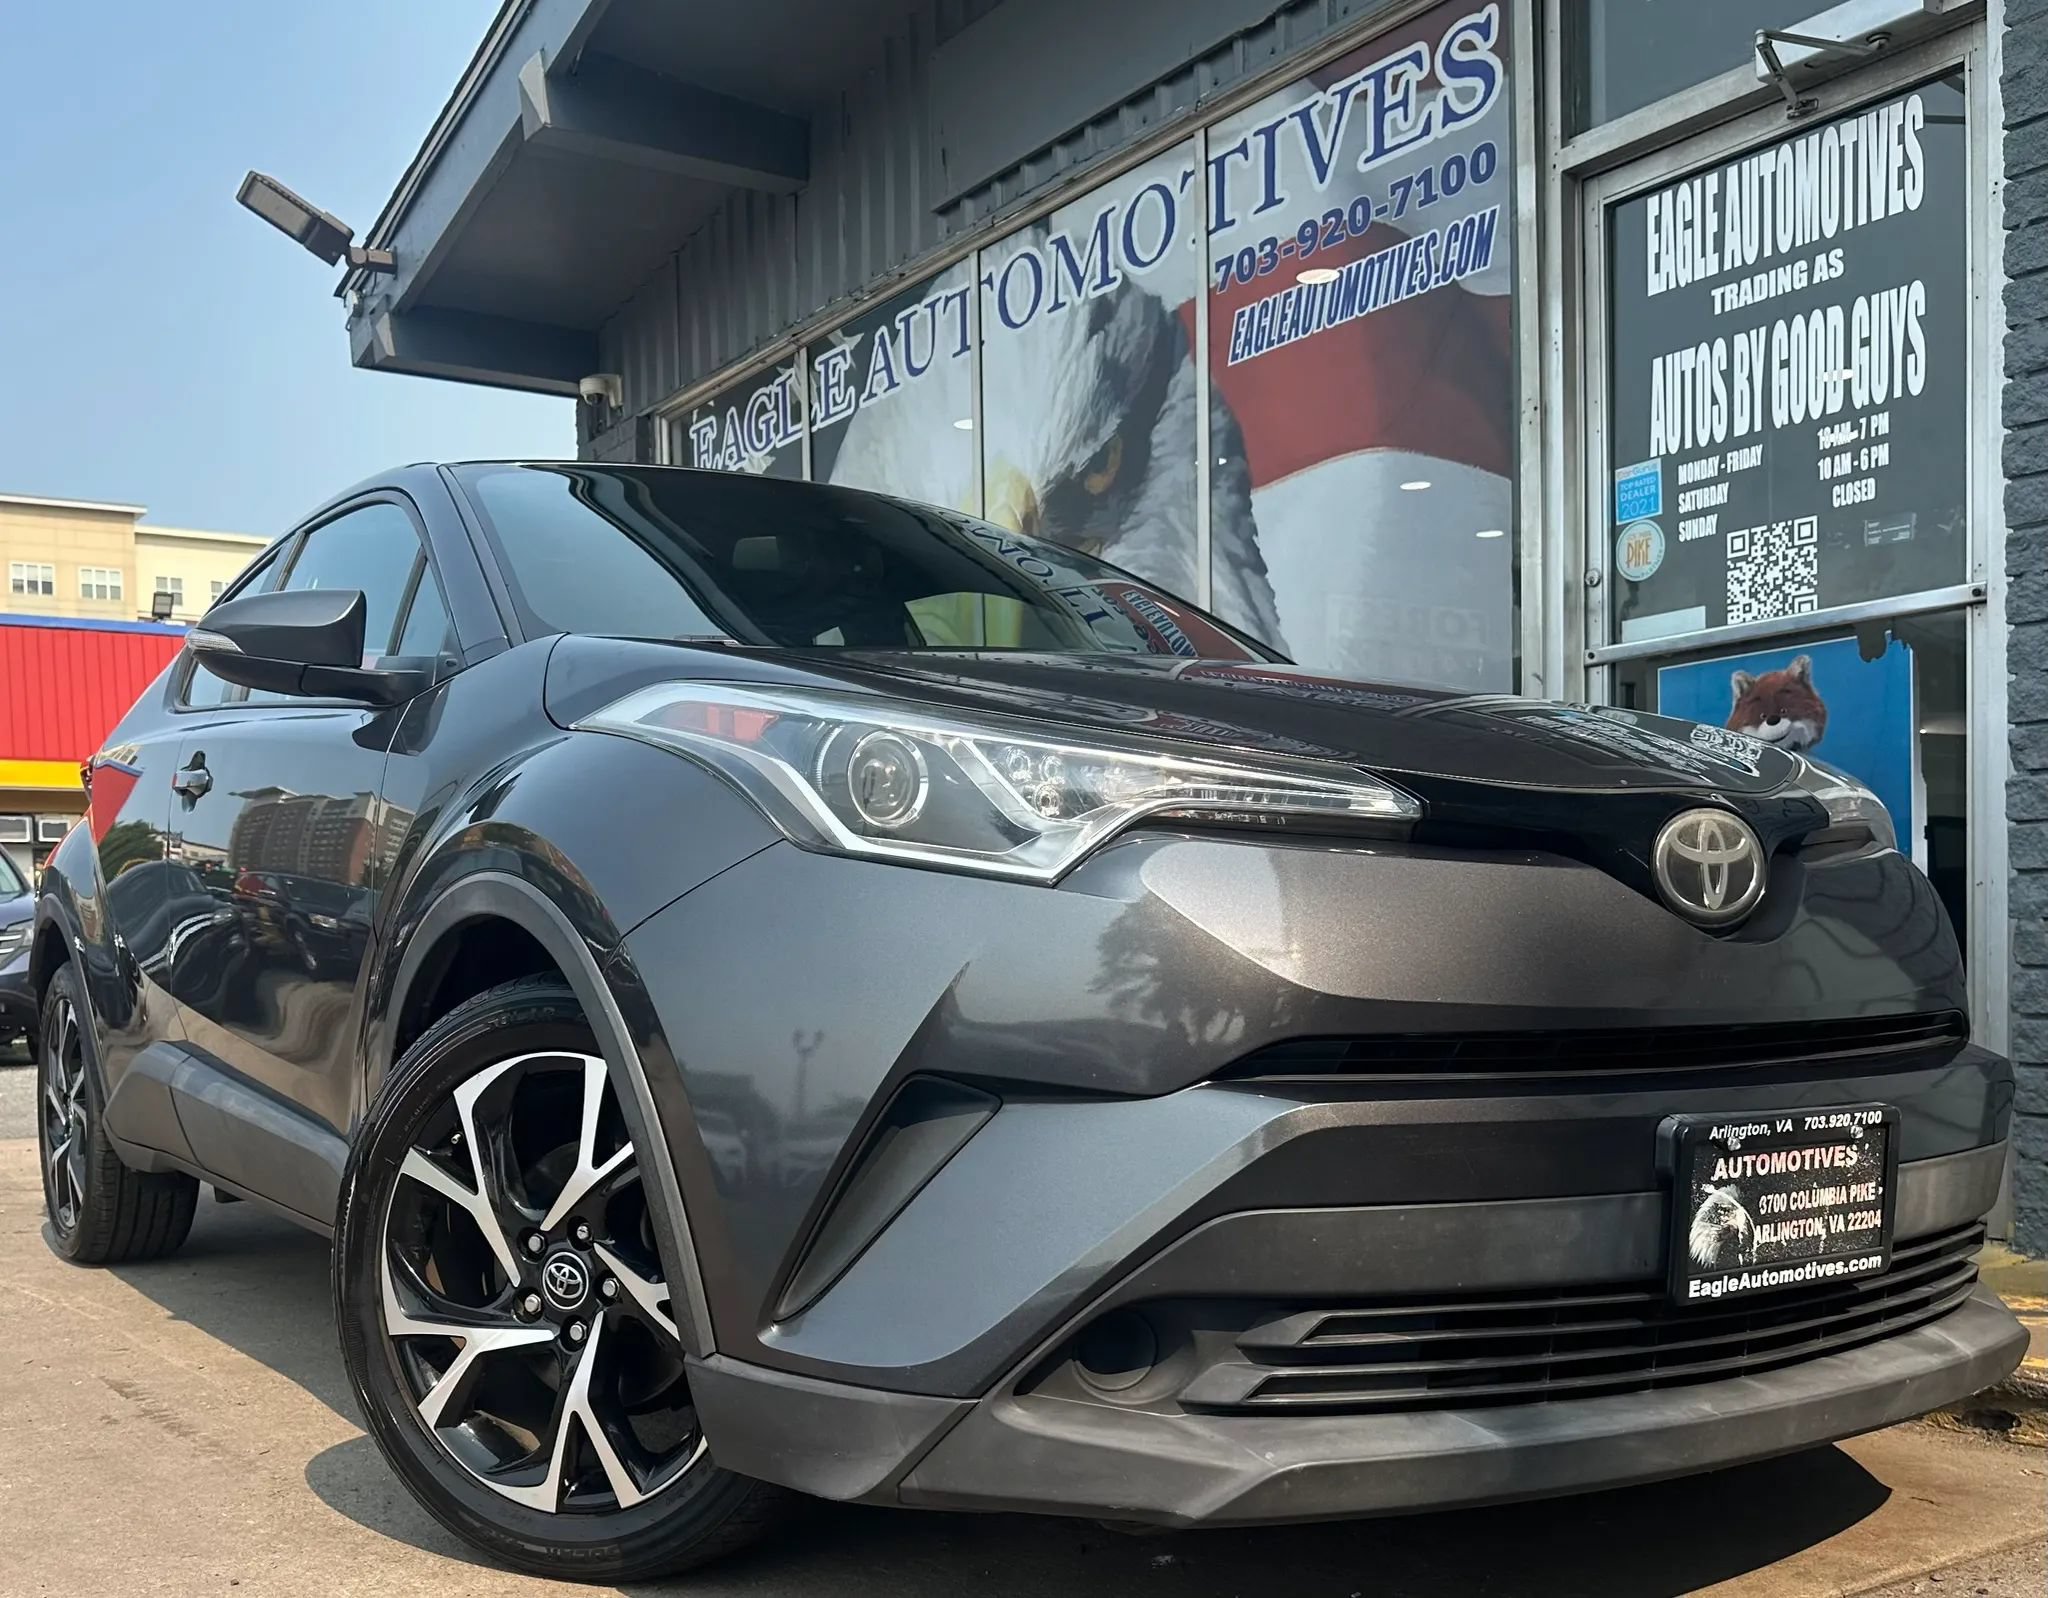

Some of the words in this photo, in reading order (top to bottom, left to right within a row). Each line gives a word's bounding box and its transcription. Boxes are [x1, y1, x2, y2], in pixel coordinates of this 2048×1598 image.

[1647, 171, 1720, 297] EAGLE
[1723, 94, 1924, 271] AUTOMOTIVES
[1215, 141, 1498, 294] 703-920-7100
[689, 342, 857, 473] EAGLE
[860, 2, 1504, 408] AUTOMOTIVES
[1227, 204, 1500, 366] EAGLEAUTOMOTIVES.COM
[1711, 260, 1808, 315] TRADING
[1812, 248, 1844, 284] AS
[1650, 337, 1728, 458] AUTOS
[1733, 325, 1767, 438] BY
[1771, 304, 1844, 430] GOOD
[1851, 279, 1926, 410] GUYS
[1859, 417, 1867, 440] 7
[1870, 411, 1889, 438] PM
[1678, 455, 1720, 486] MONDAY
[1726, 443, 1764, 474] FRIDAY
[1817, 456, 1832, 481] 10
[1832, 451, 1852, 478] AM
[1860, 447, 1869, 471] 6
[1870, 442, 1889, 469] PM
[1620, 485, 1656, 502] DEALER
[1621, 496, 1656, 519] 2021
[1678, 482, 1729, 514] SATURDAY
[1832, 477, 1876, 508] CLOSED
[1678, 513, 1718, 542] SUNDAY
[1626, 538, 1651, 569] PIKE
[1709, 1124, 1771, 1141] Arlington,
[1776, 1119, 1793, 1133] VA
[1804, 1110, 1882, 1130] 703.920.7100
[1711, 1145, 1858, 1180] AUTOMOTIVES
[1789, 1185, 1847, 1210] COLUMBIA
[1849, 1181, 1876, 1203] PIKE
[1828, 1214, 1845, 1233] VA
[1847, 1209, 1882, 1232] 22204
[1688, 1255, 1882, 1298] EagleAutomotives.com
